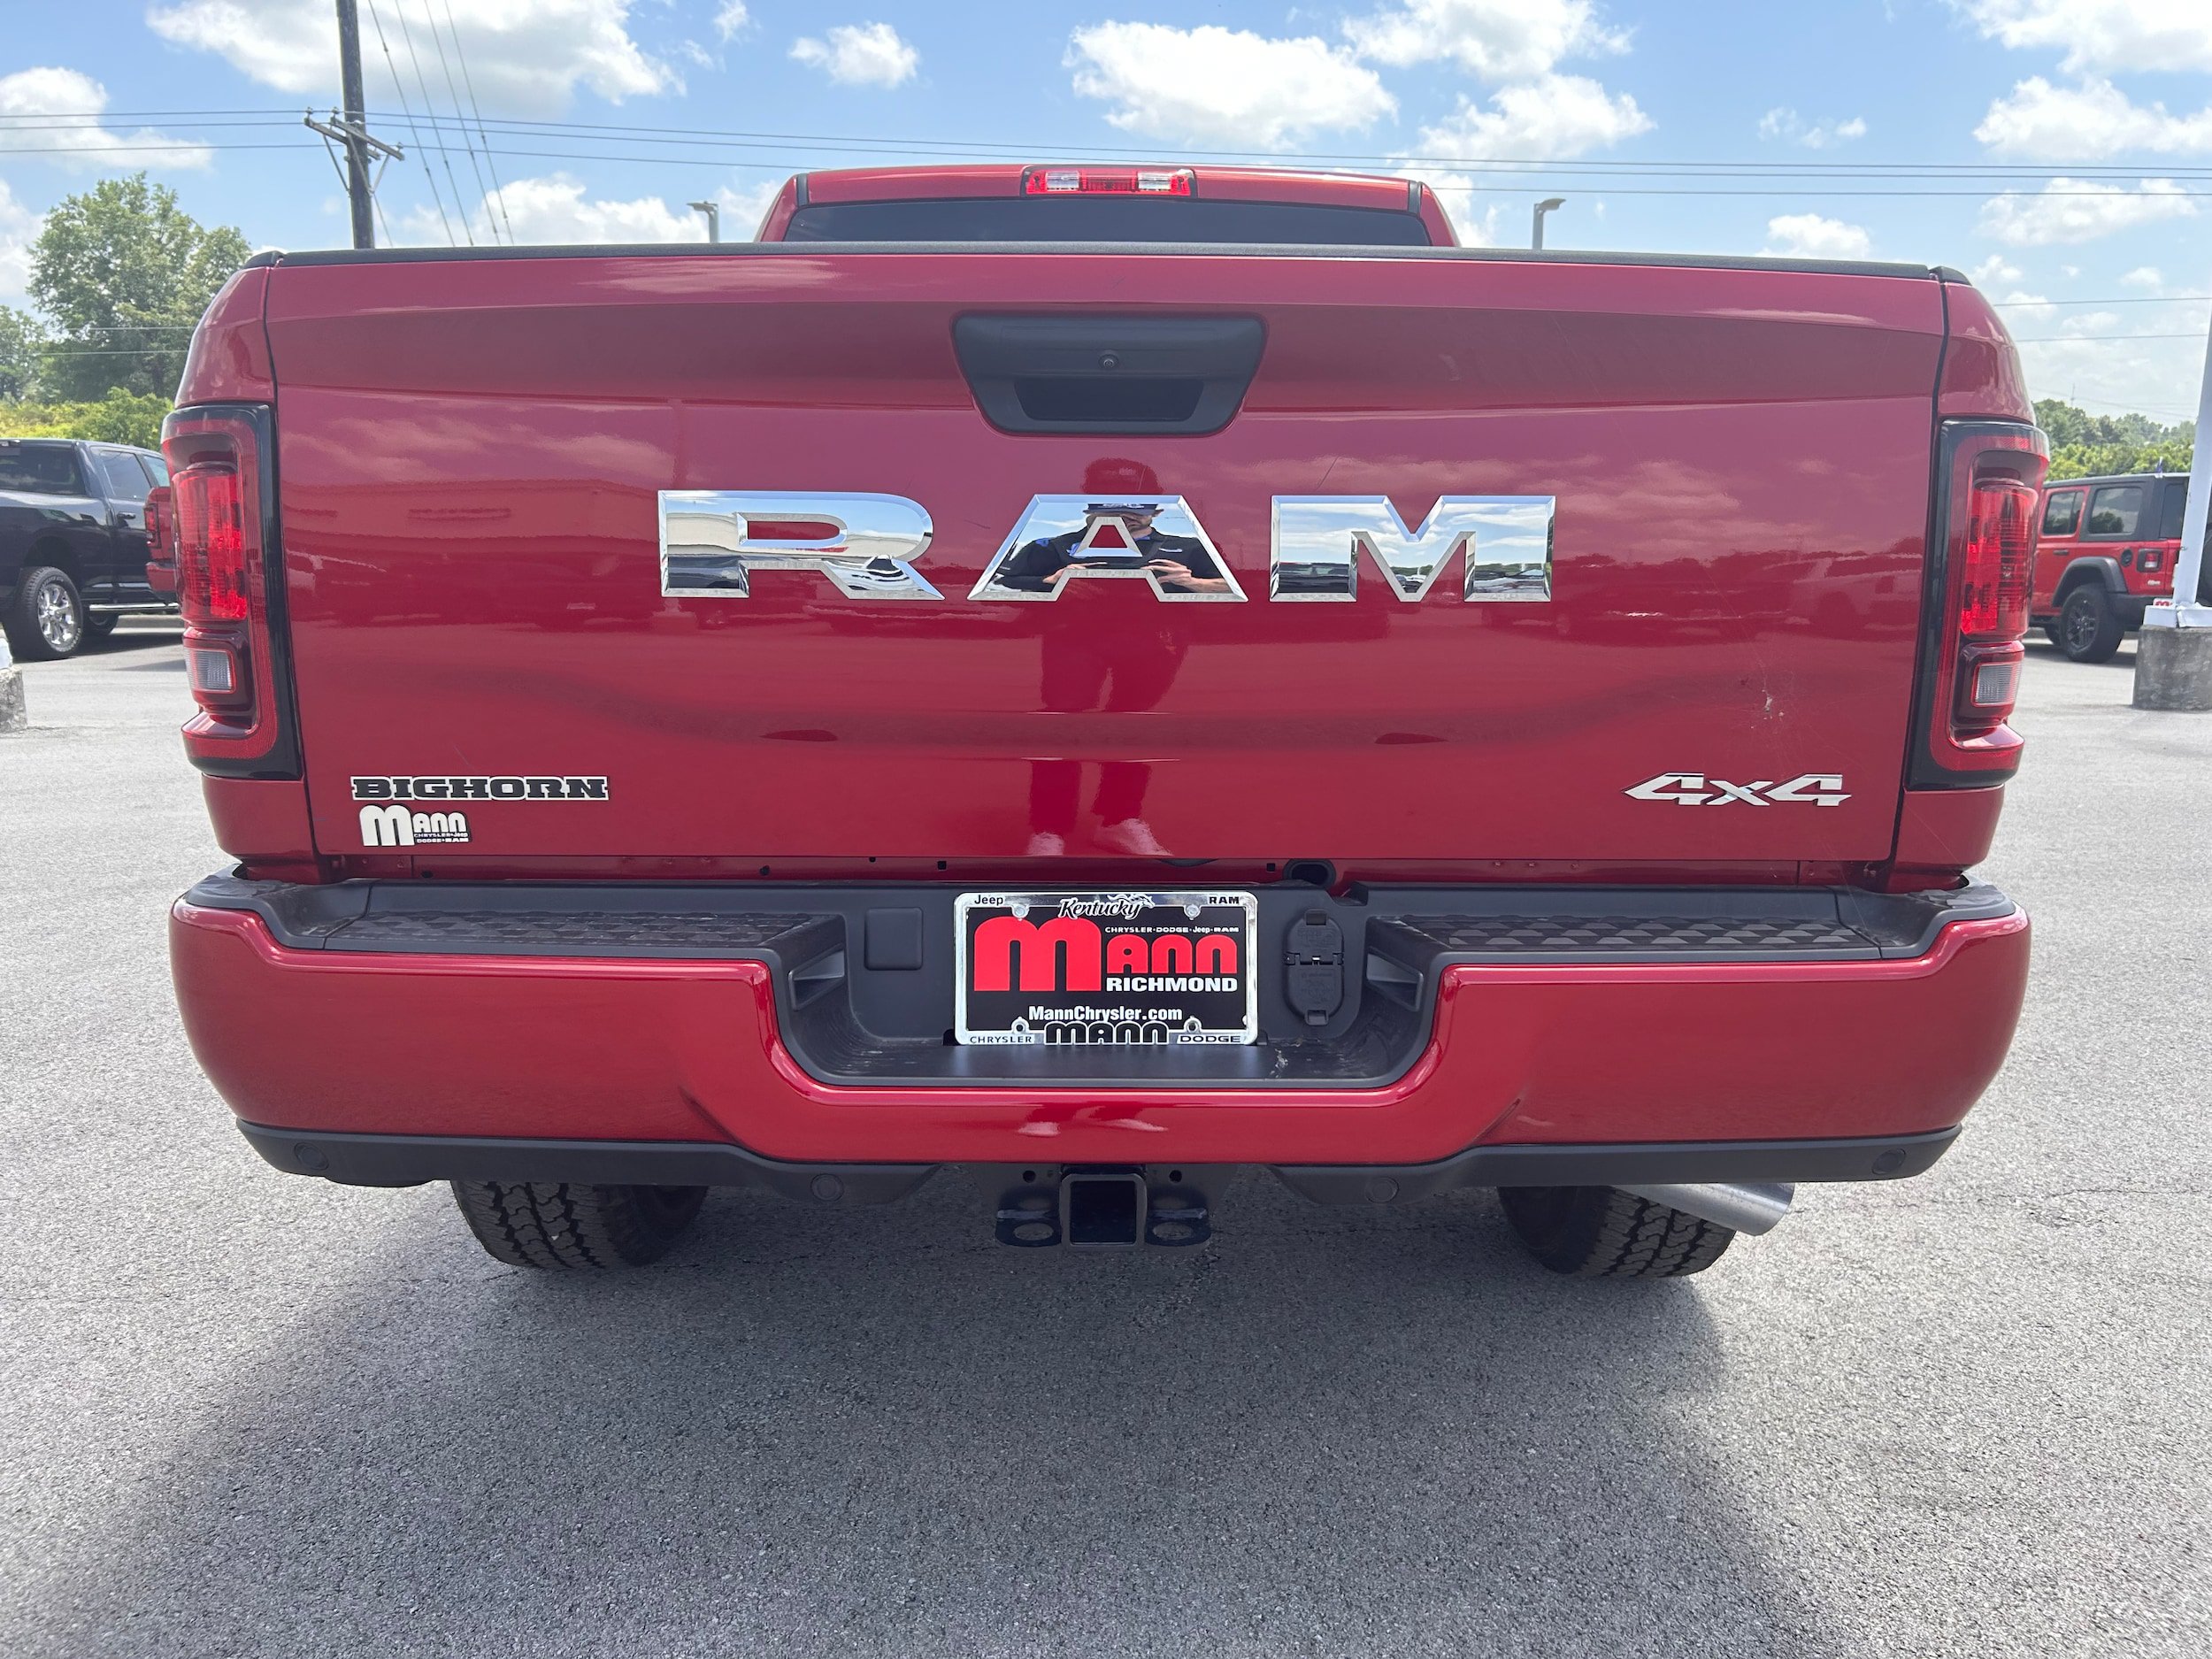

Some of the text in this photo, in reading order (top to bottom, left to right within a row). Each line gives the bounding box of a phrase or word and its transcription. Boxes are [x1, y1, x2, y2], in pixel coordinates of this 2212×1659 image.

[657, 490, 1557, 603] RAM
[350, 775, 610, 801] BIGHORN
[1623, 772, 1853, 806] 4x4
[974, 895, 1003, 905] Jeep
[1059, 897, 1142, 919] Kentucky
[1106, 977, 1238, 992] RICHMOND
[1029, 1006, 1183, 1021] MannChrysler.com
[970, 1035, 1033, 1044] CHRYSLER
[1179, 1034, 1241, 1043] DODGE
